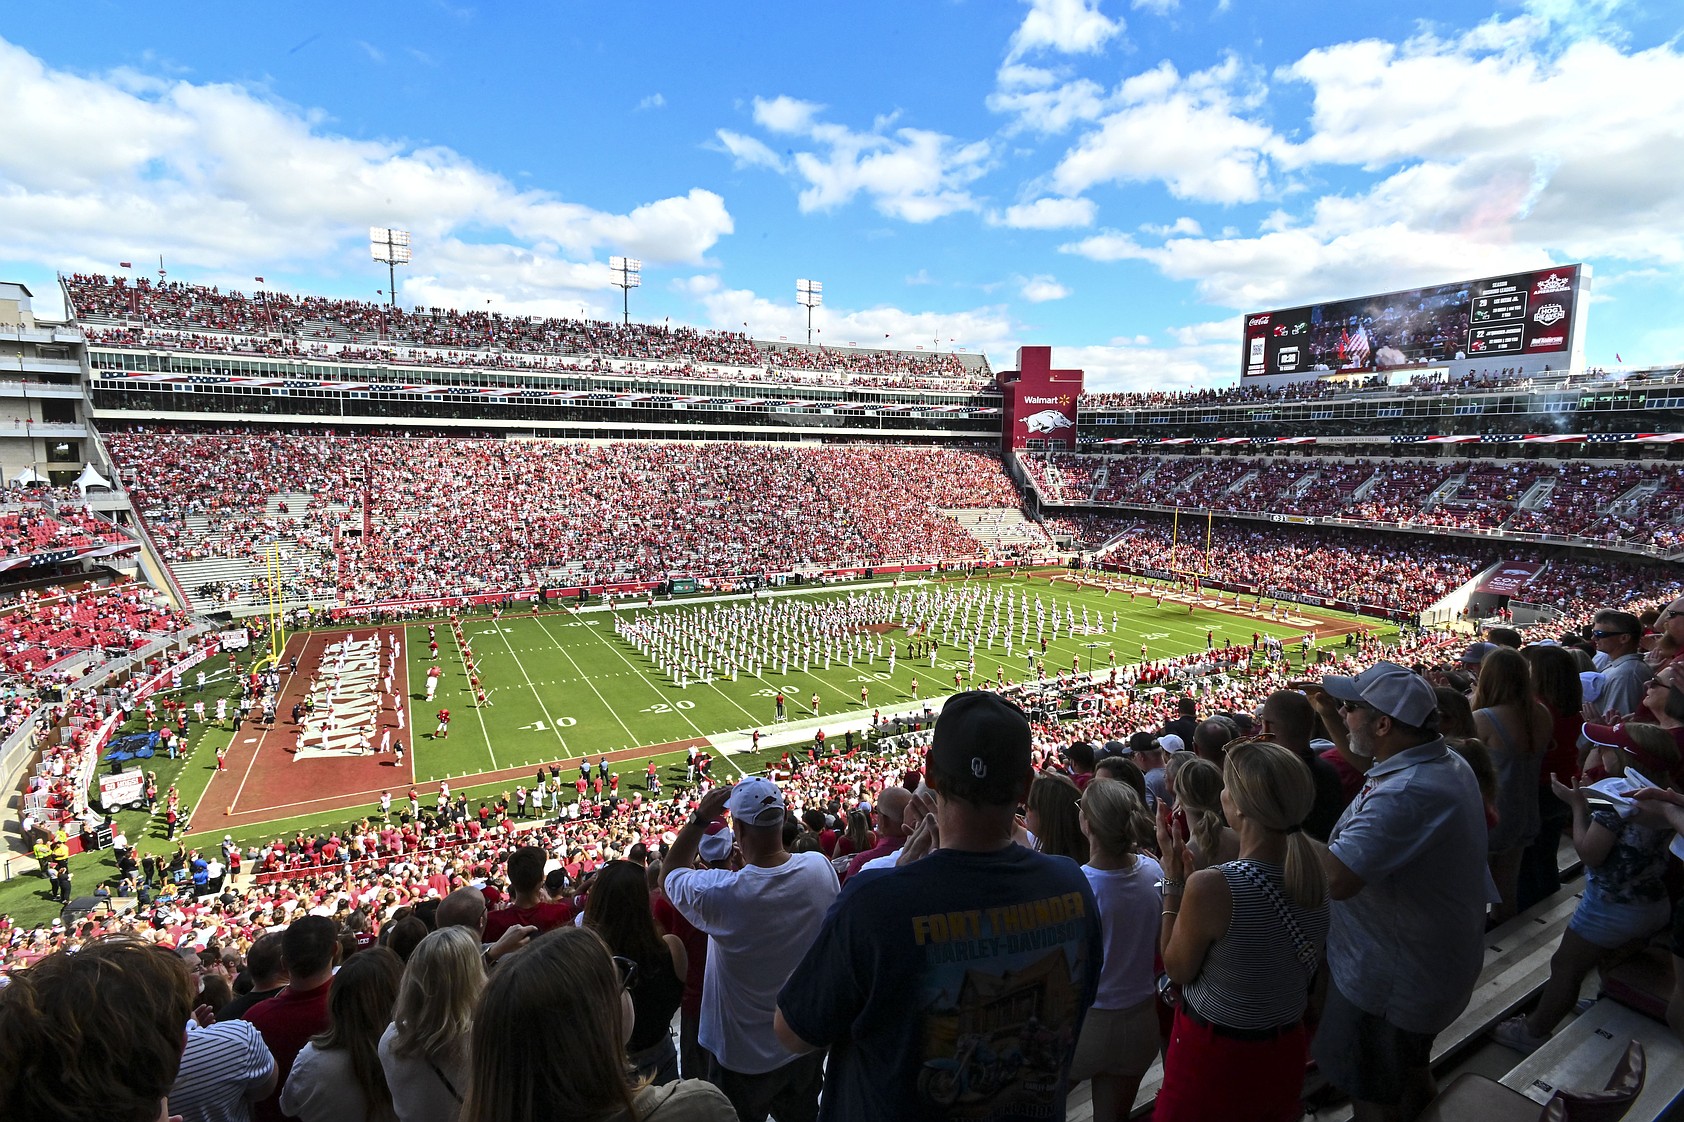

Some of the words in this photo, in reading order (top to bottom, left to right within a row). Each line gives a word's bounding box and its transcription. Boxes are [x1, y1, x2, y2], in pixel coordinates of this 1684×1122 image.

[1536, 312, 1563, 320] HEAVEN
[1024, 395, 1059, 404] Walmart
[854, 672, 892, 683] 40
[757, 685, 800, 698] 30
[293, 640, 382, 762] ARKANSAS
[650, 700, 696, 714] 20
[531, 716, 577, 732] 10
[971, 756, 988, 779] OU
[105, 782, 116, 791] GO
[117, 778, 138, 789] HOGS!
[912, 909, 982, 946] FORT
[986, 892, 1086, 938] THUNDER
